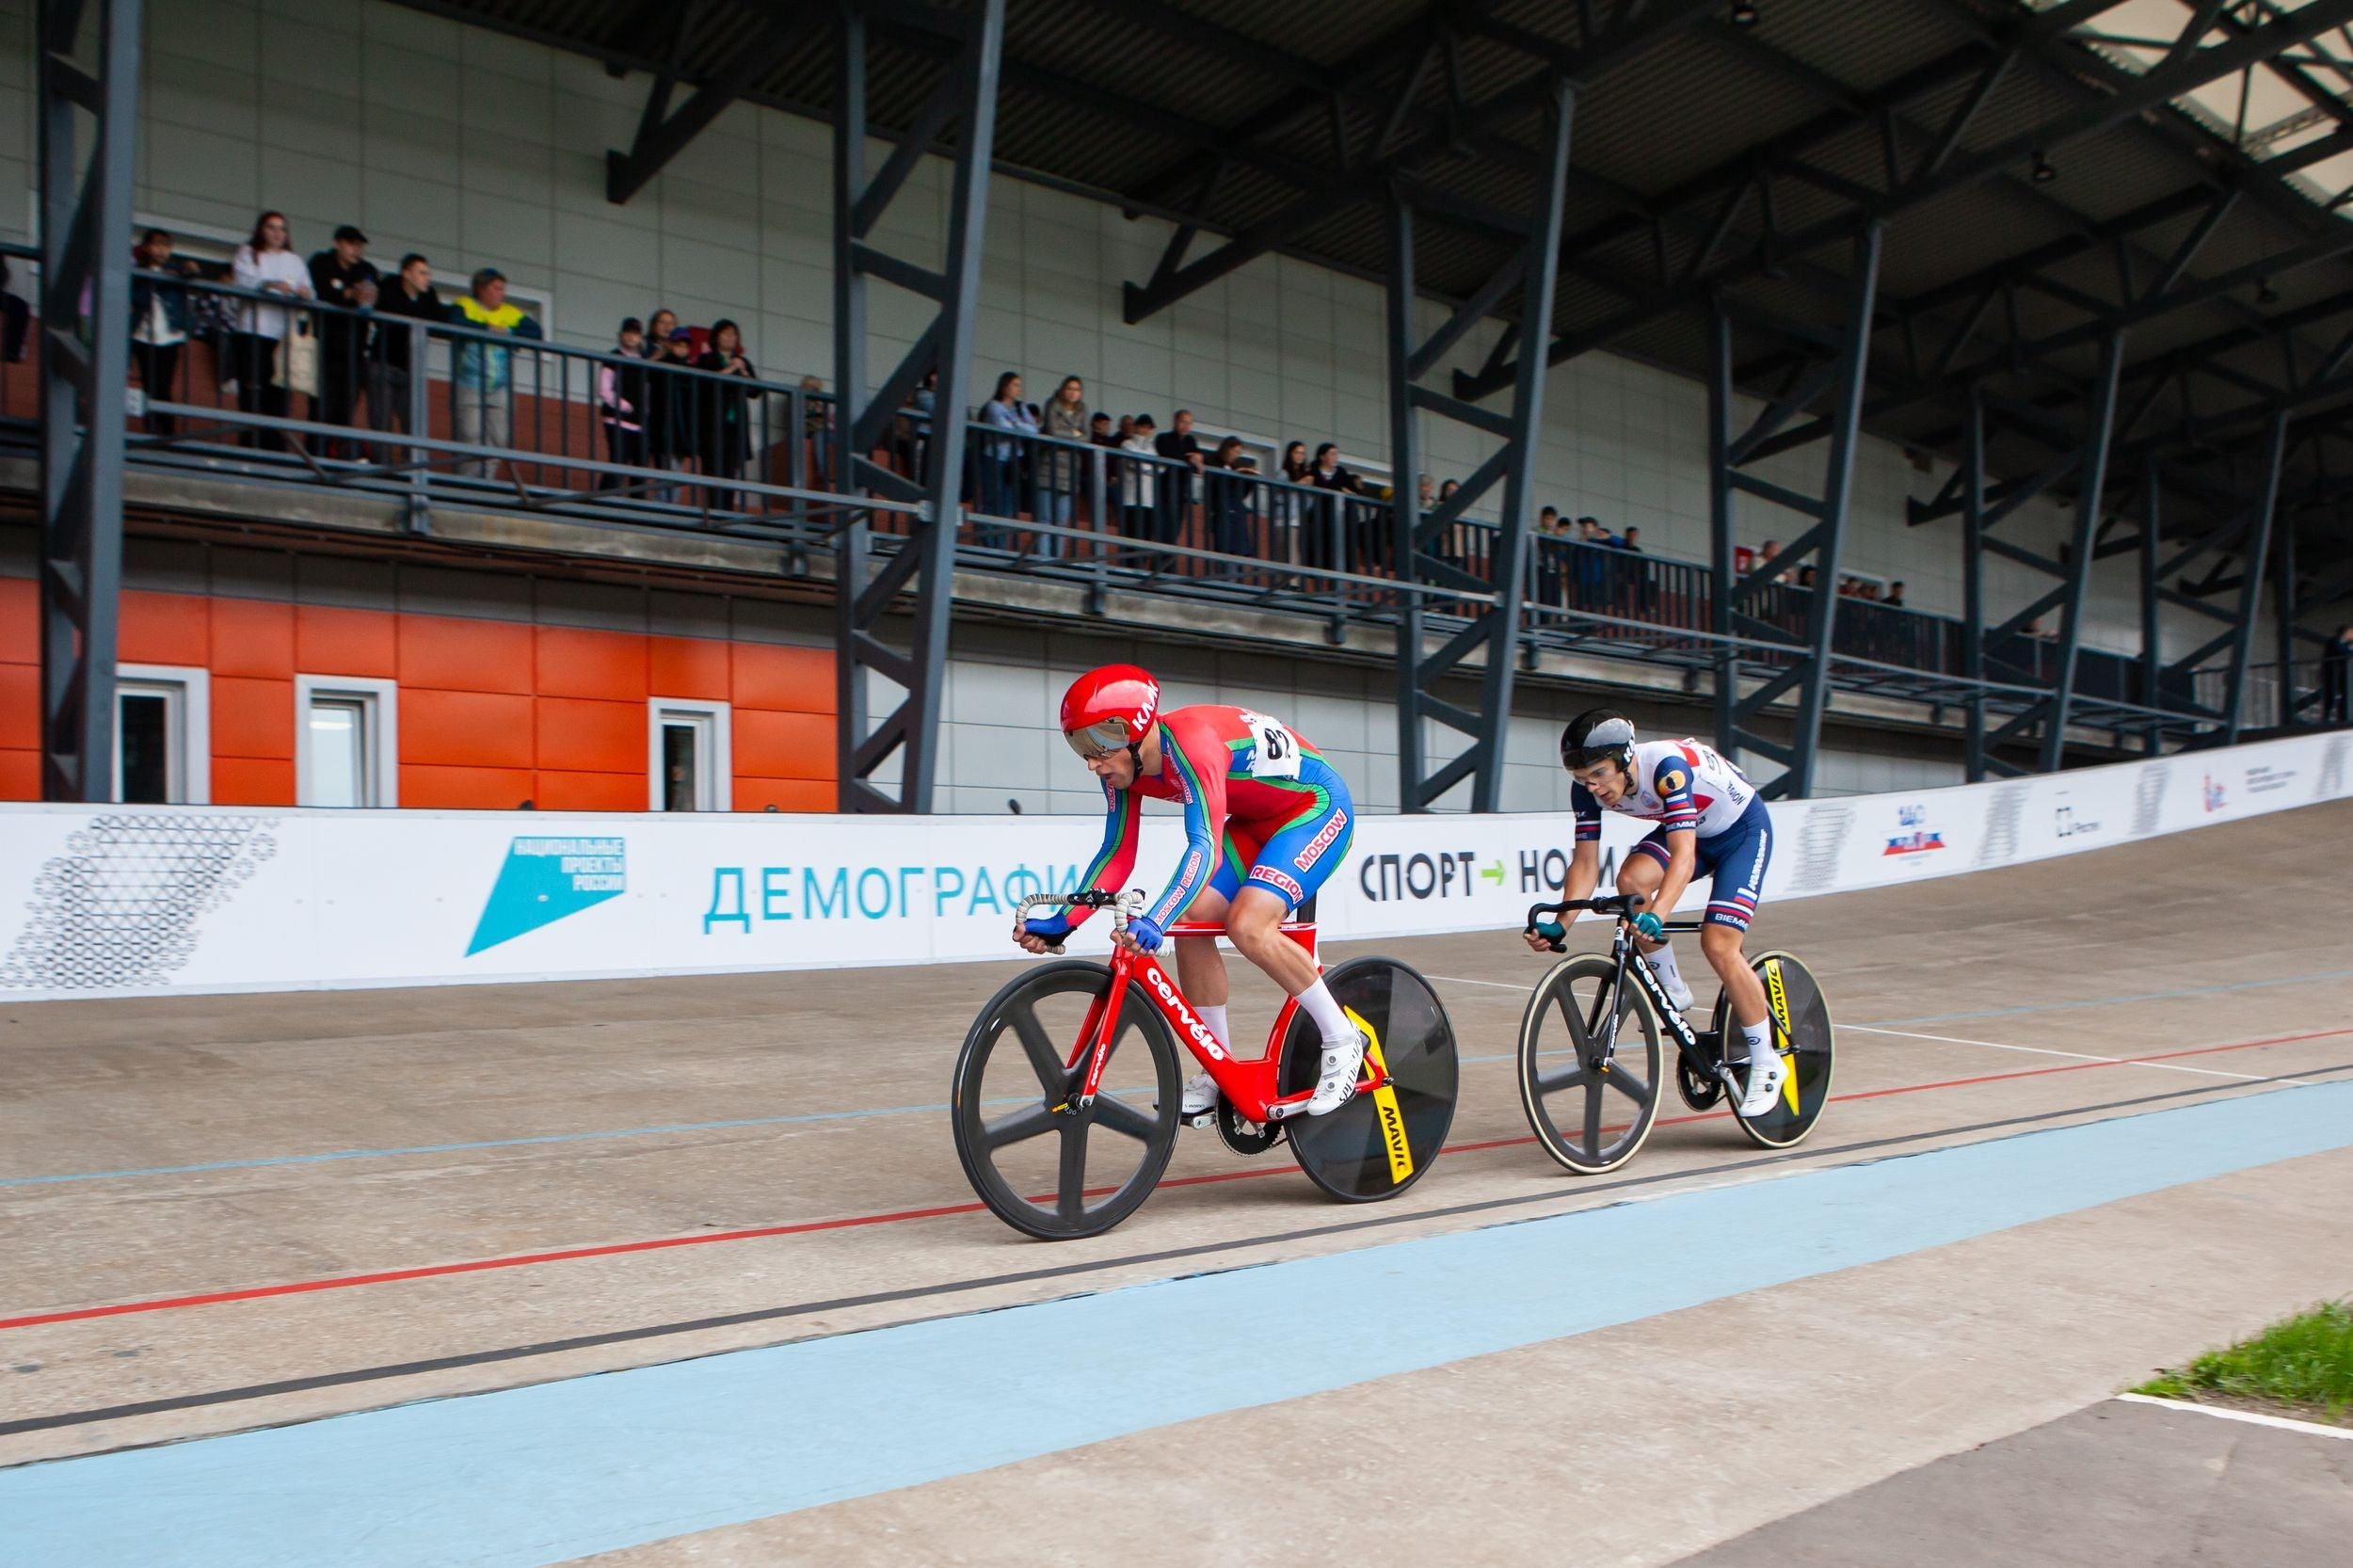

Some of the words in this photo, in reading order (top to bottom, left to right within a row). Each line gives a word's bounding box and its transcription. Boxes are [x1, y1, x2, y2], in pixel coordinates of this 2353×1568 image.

[1294, 807, 1348, 873] MOSCOW
[702, 862, 1082, 936] ДЕМОГРАФИ
[1155, 885, 1187, 927] MOSCOW
[1179, 850, 1203, 888] REGION
[1249, 864, 1304, 904] REGION
[1360, 851, 1475, 902] СПОРТ
[1146, 967, 1225, 1062] cervélo
[1769, 965, 1786, 1028] MAVIC
[1383, 1106, 1408, 1172] MAVIC
